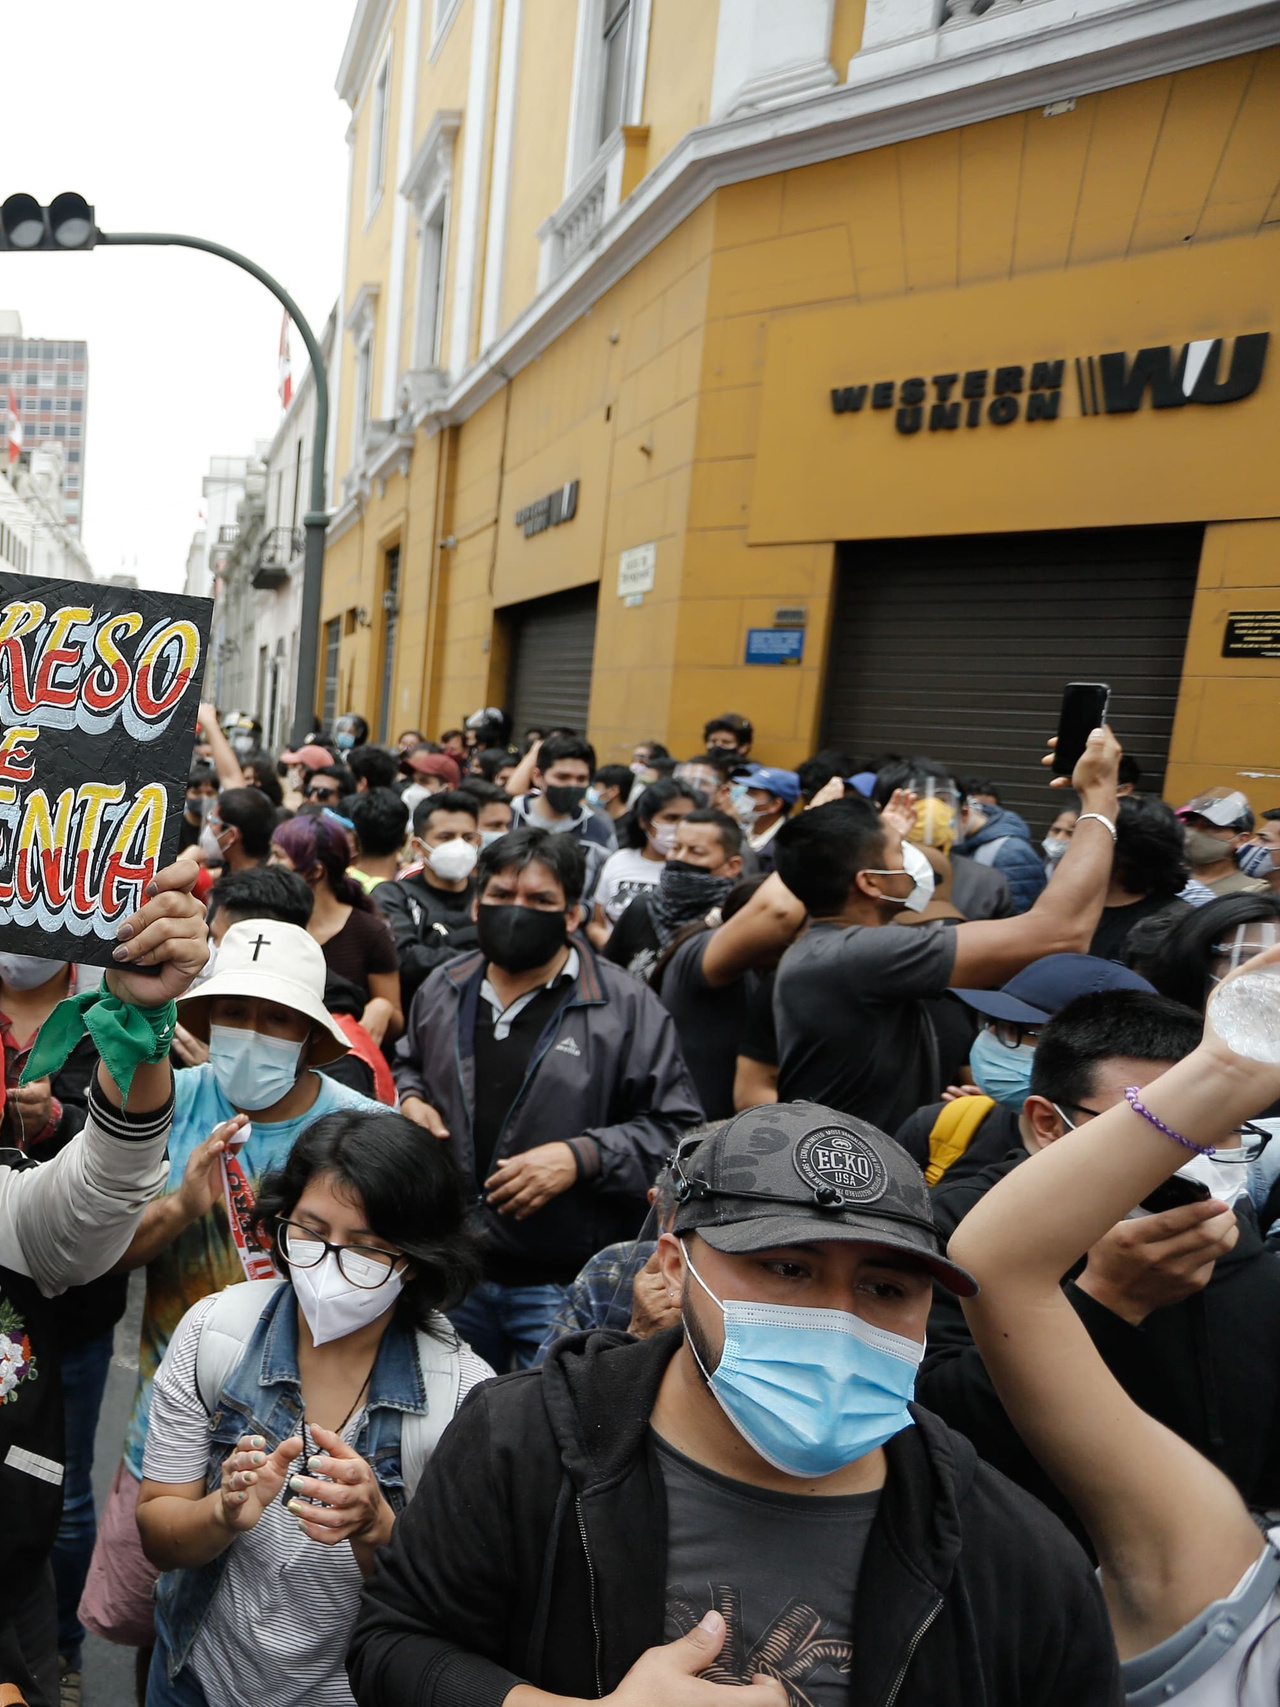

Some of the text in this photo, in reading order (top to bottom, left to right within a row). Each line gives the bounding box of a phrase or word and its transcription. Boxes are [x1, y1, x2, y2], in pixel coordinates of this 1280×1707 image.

[830, 359, 1065, 414] WESTERN
[1099, 331, 1271, 415] WU
[895, 390, 1062, 435] UNION
[816, 1149, 869, 1178] ECKO
[835, 1172, 857, 1186] USA
